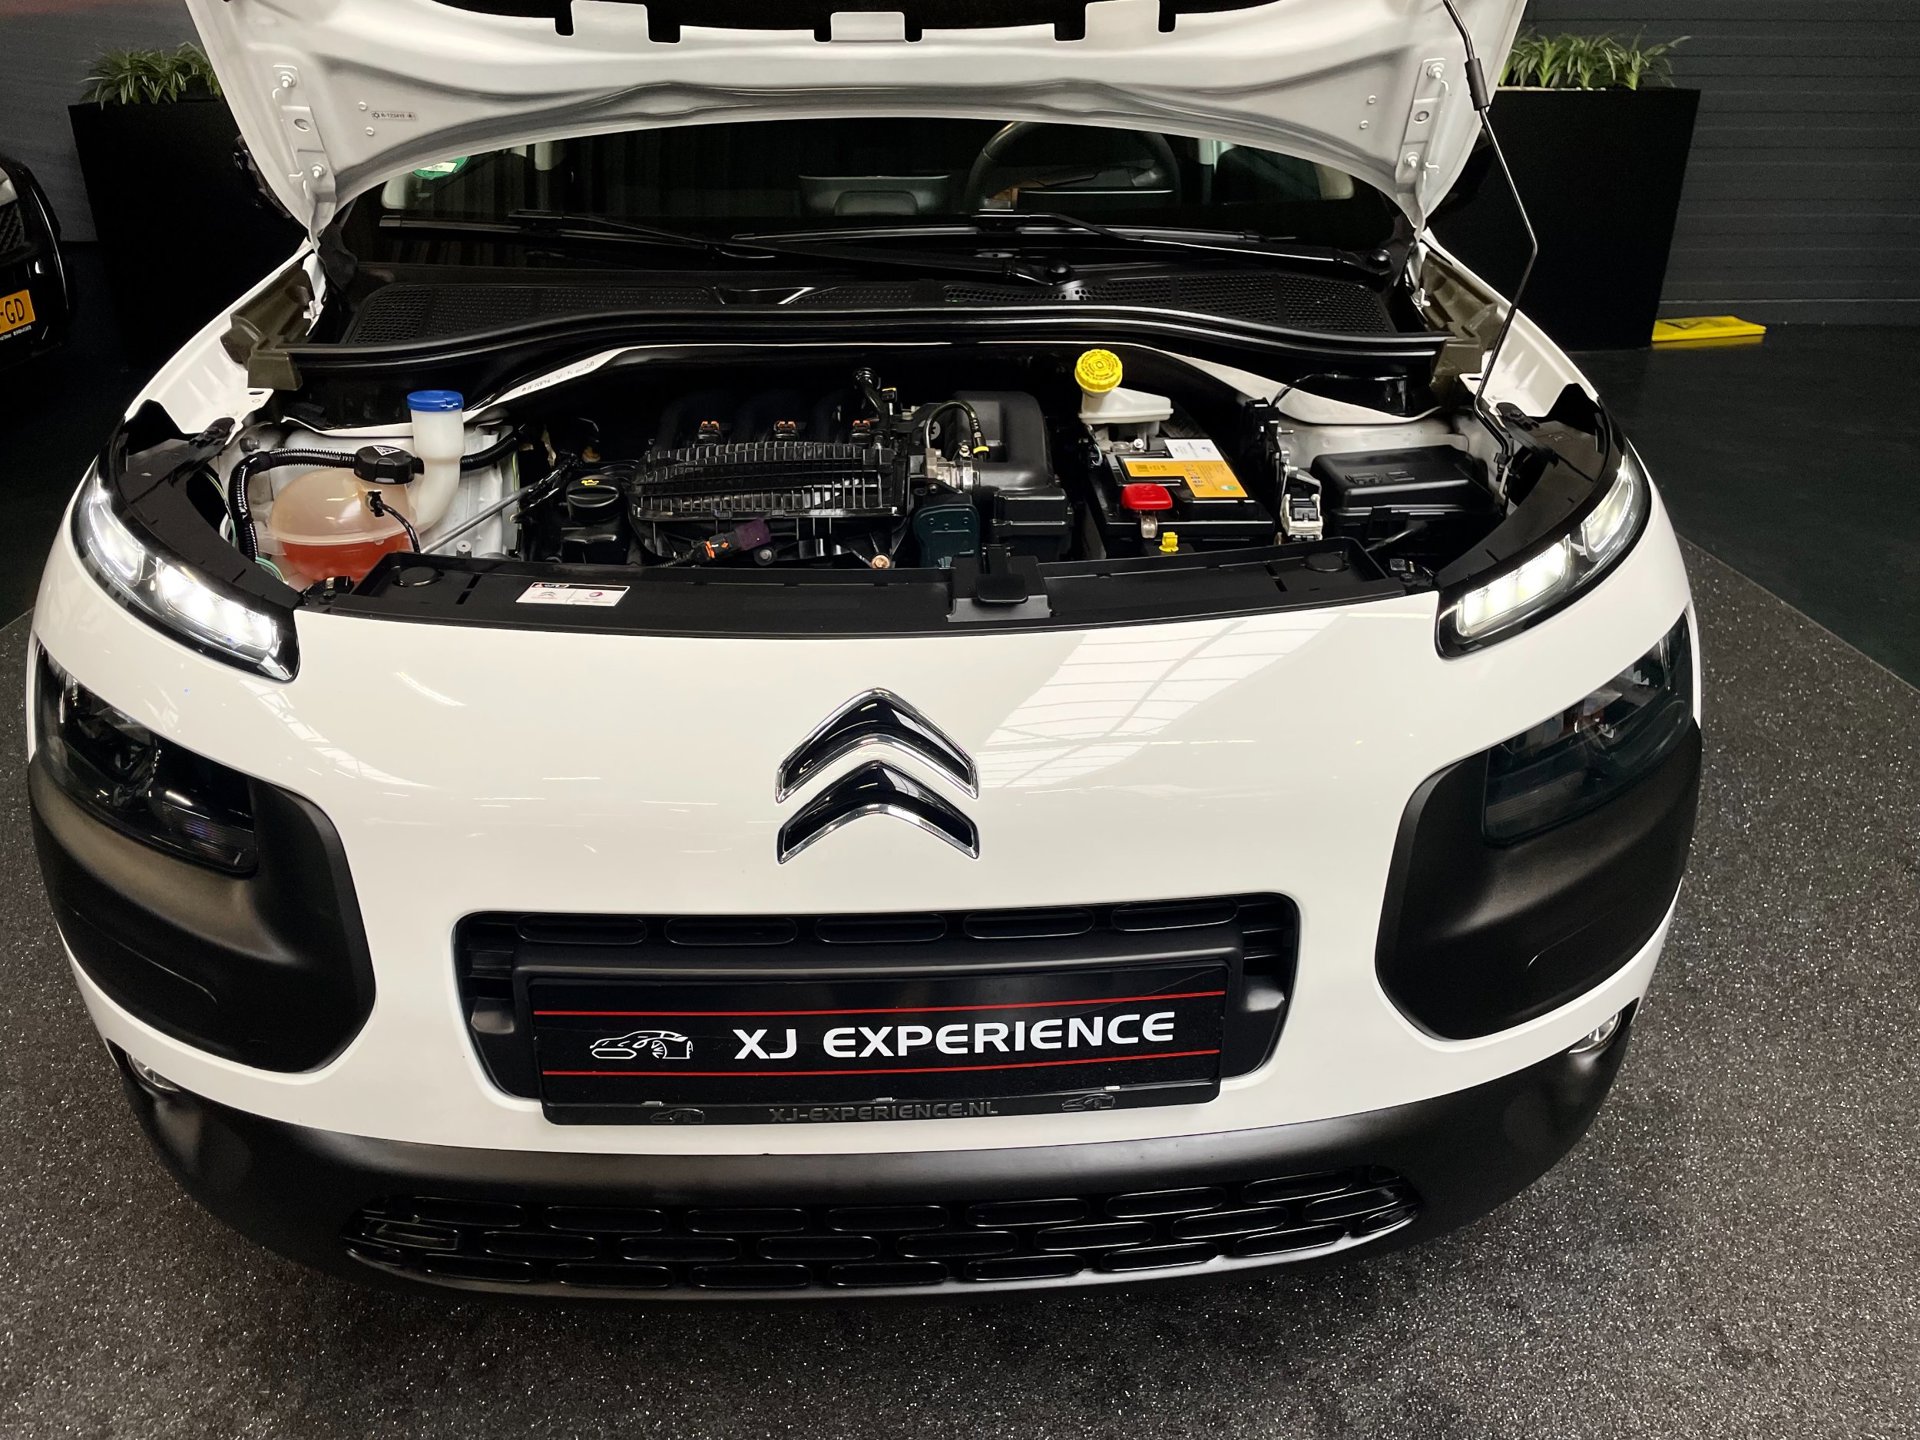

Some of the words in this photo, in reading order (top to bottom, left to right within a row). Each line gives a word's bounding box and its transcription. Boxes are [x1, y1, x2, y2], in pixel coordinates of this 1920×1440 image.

[733, 1029, 797, 1060] XJ
[823, 1011, 1176, 1058] EXPERIENCE
[769, 1101, 999, 1123] XJ-EXPERIENCE.NL
